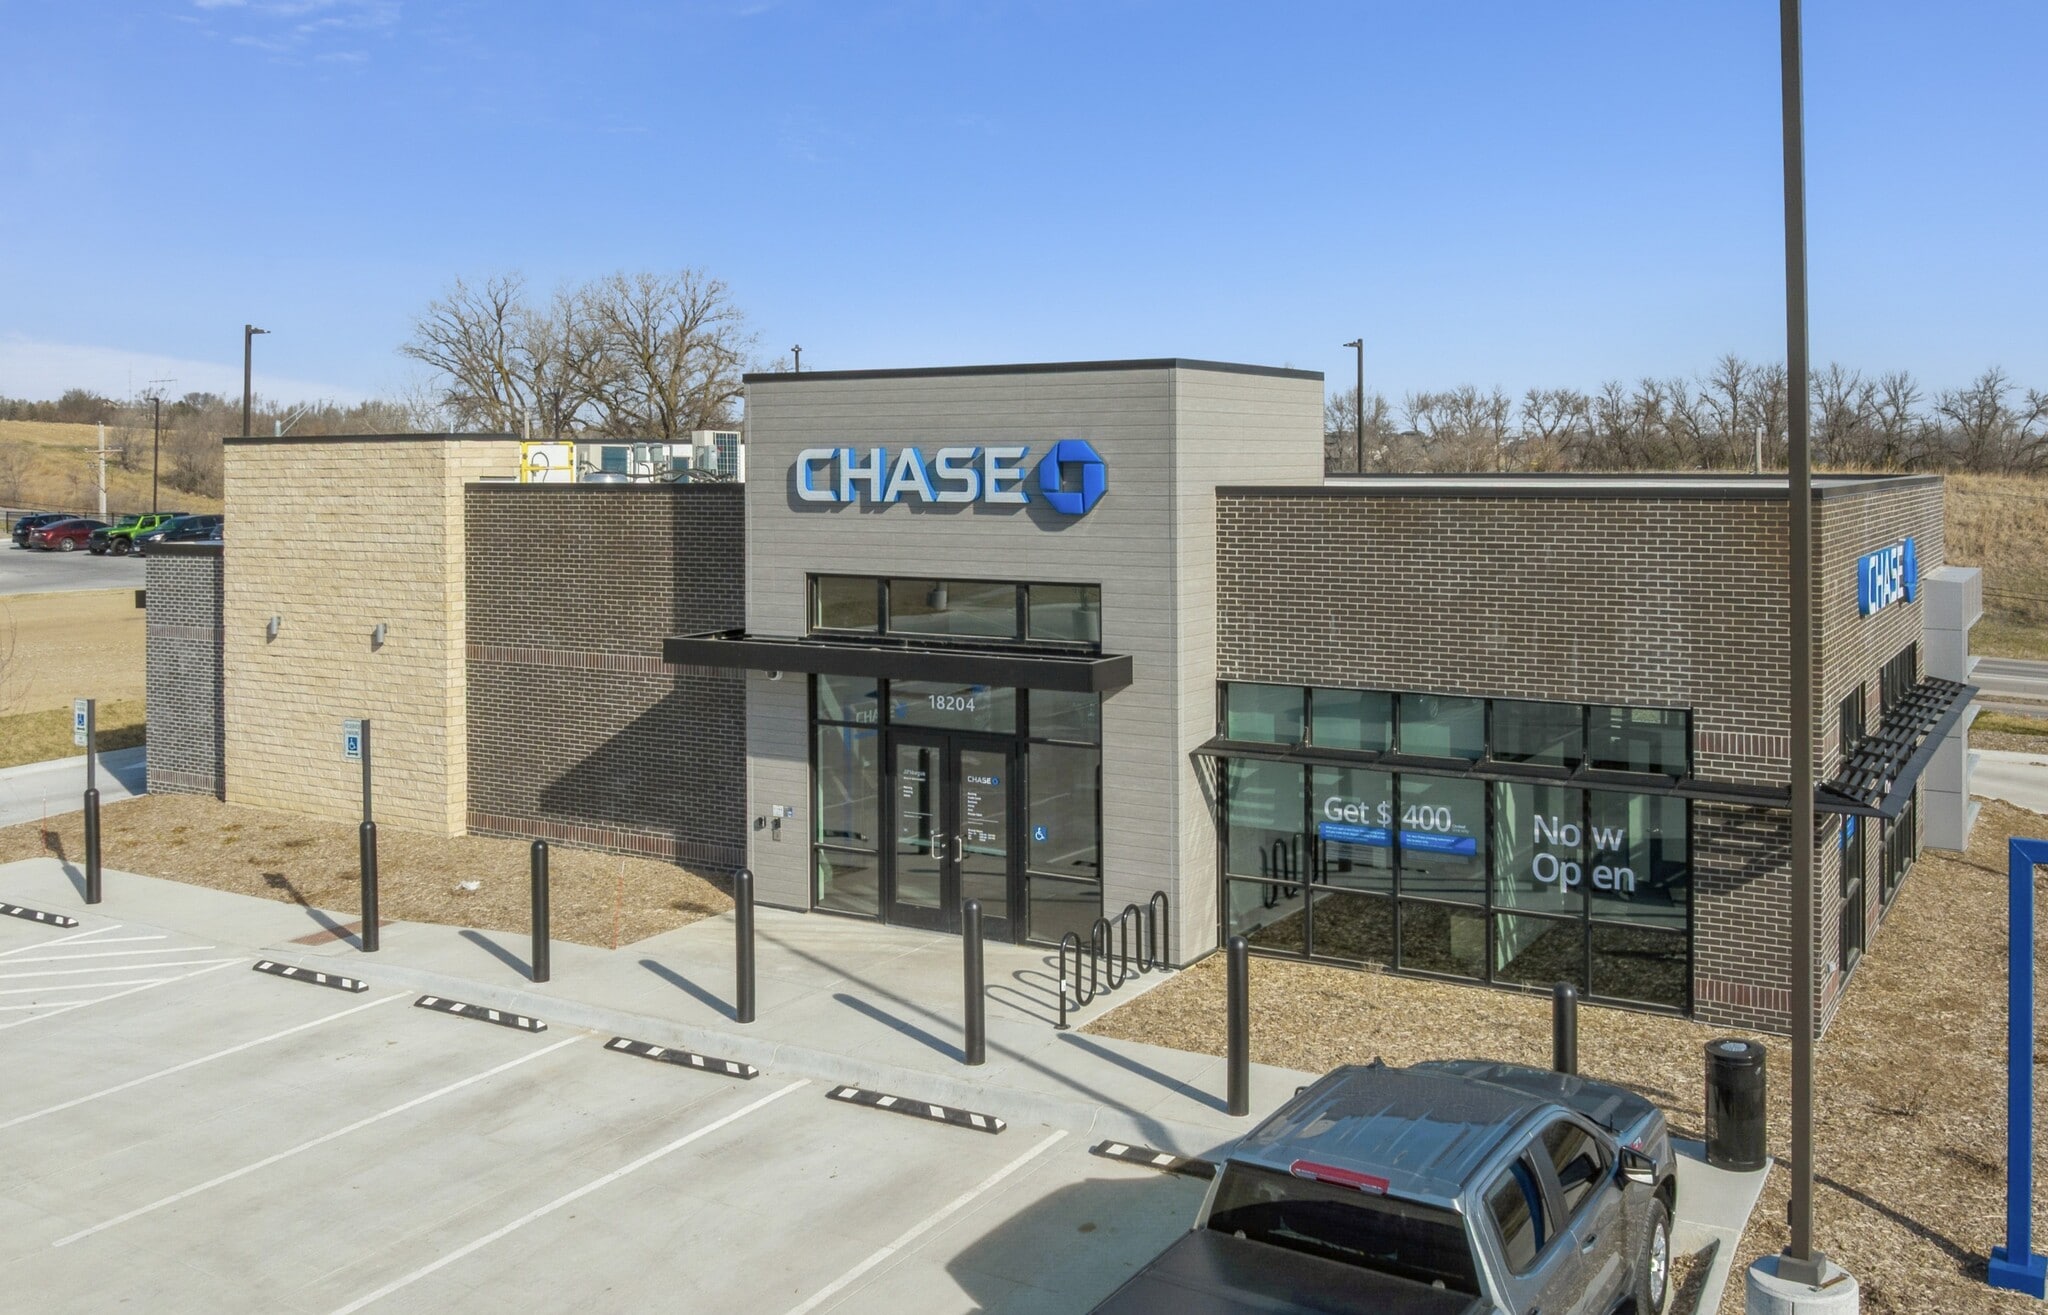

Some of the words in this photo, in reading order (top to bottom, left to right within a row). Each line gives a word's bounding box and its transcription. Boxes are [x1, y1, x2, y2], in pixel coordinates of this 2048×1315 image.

[796, 447, 1030, 503] CHASE
[1867, 545, 1905, 616] CHASE
[928, 694, 976, 712] 18204
[967, 775, 992, 785] CHASE
[1324, 796, 1370, 825] Get
[1533, 814, 1624, 851] Now
[1532, 852, 1635, 893] Open
